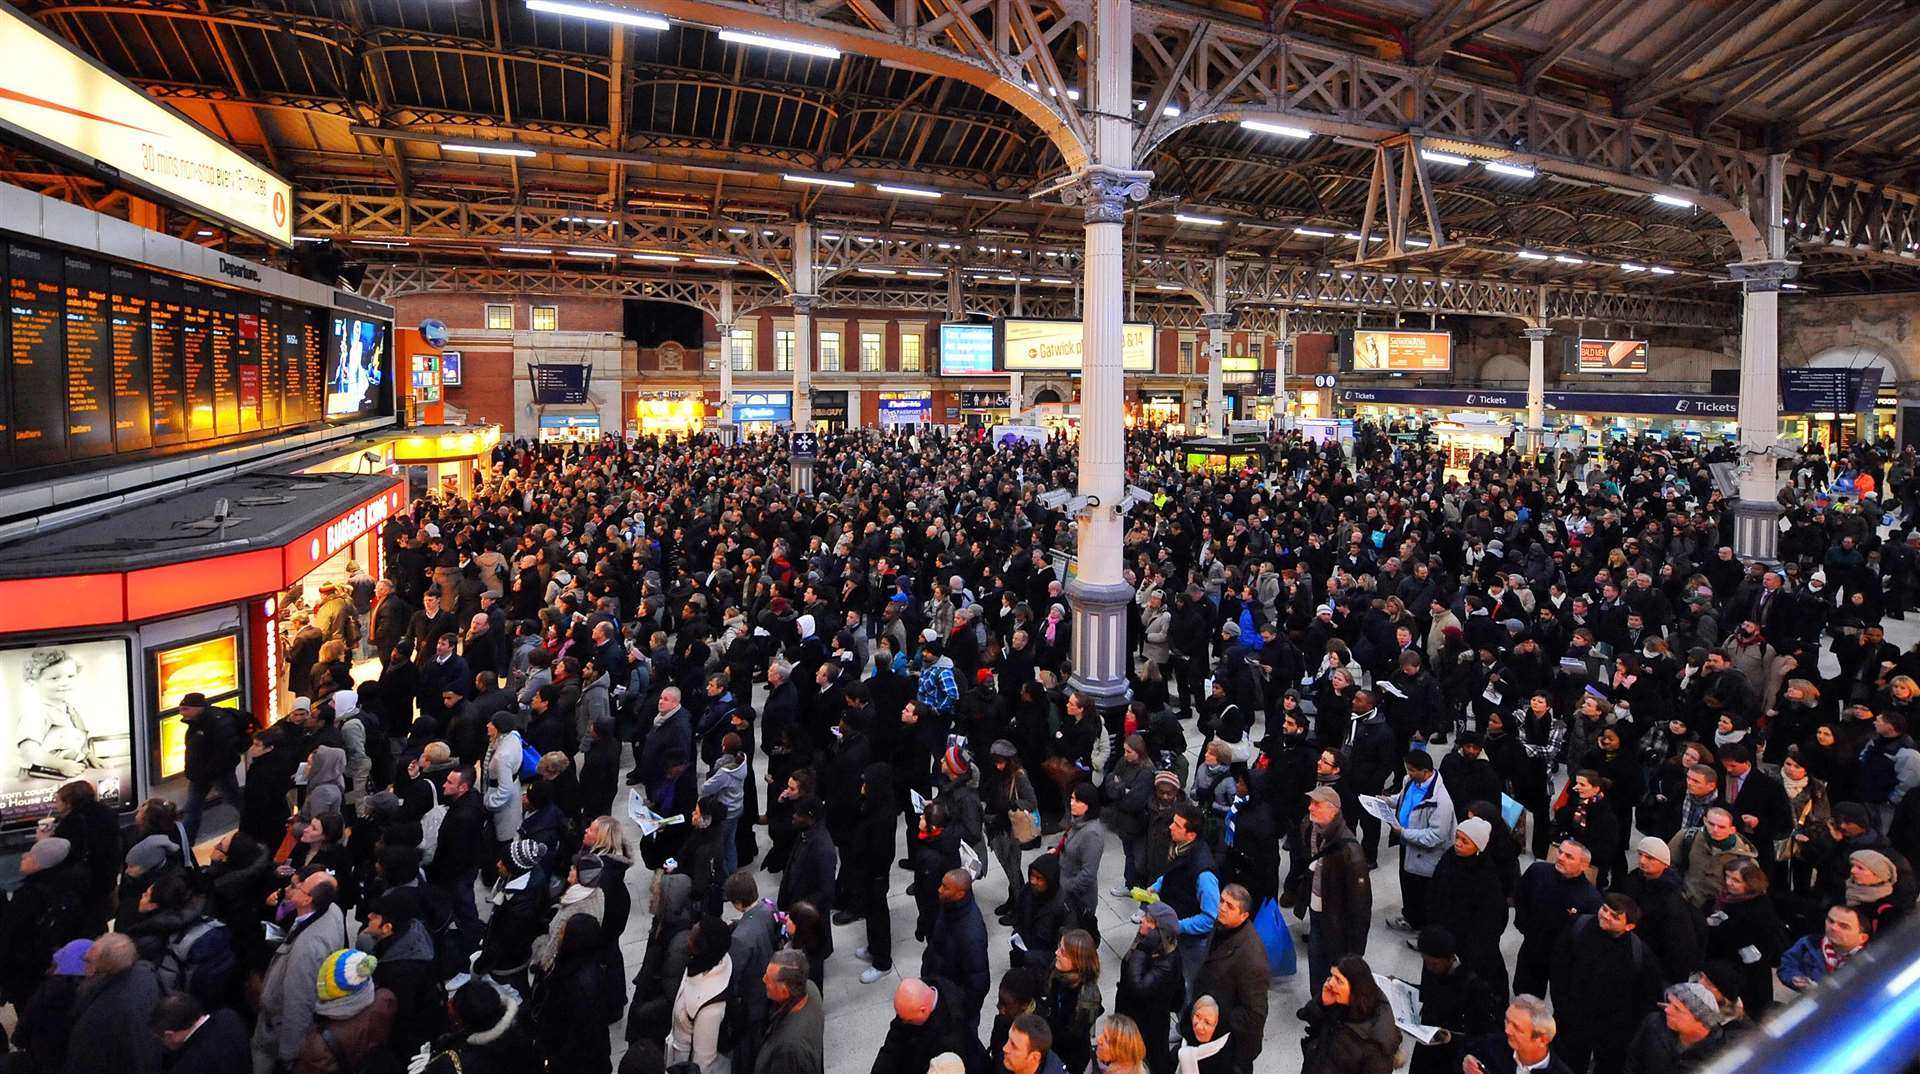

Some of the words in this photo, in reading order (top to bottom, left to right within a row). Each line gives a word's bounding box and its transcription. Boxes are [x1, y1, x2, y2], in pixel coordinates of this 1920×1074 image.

[142, 143, 155, 172] 30
[156, 153, 179, 177] mins
[1040, 340, 1074, 358] Gatwick
[1355, 392, 1375, 400] Tickets
[1479, 395, 1507, 404] Tickets
[1695, 401, 1736, 412] Tickets
[326, 508, 366, 555] BURGER
[367, 495, 388, 528] KING
[0, 790, 22, 801] rom
[9, 796, 41, 808] House
